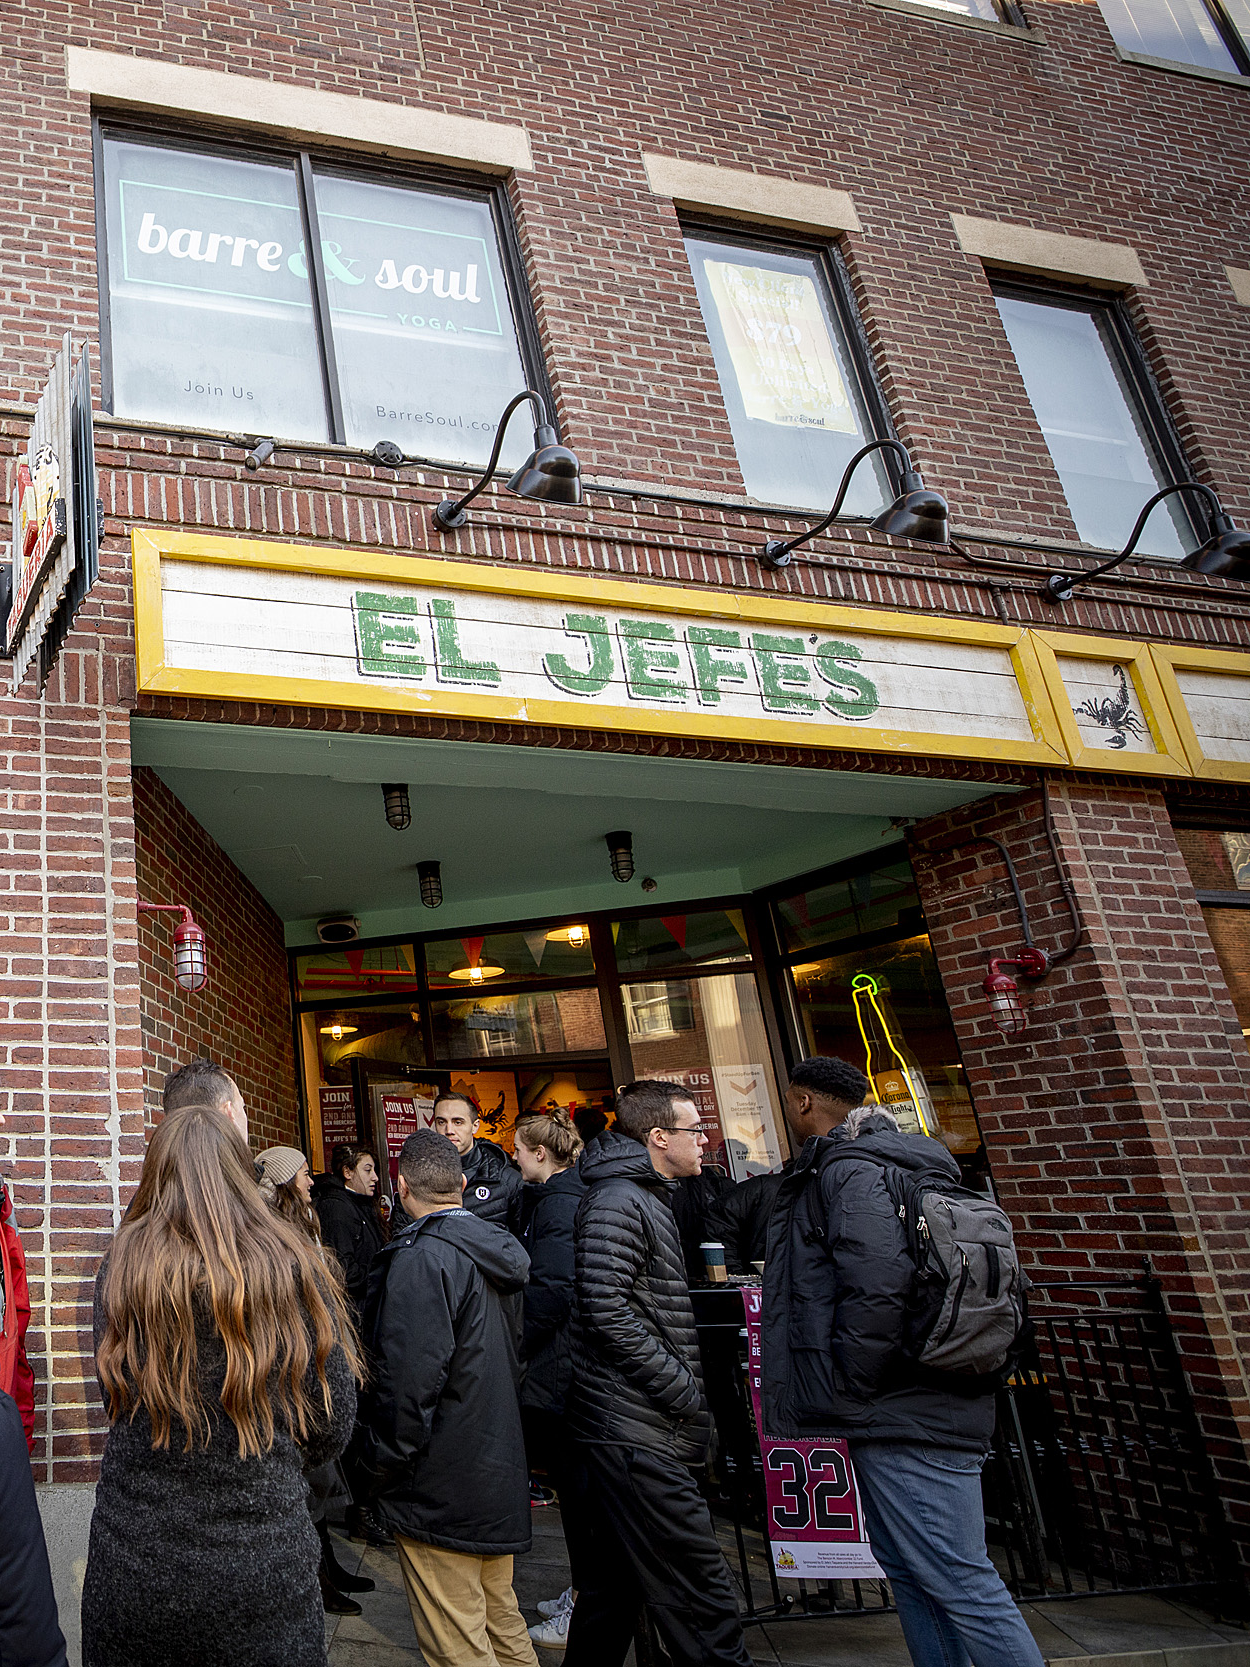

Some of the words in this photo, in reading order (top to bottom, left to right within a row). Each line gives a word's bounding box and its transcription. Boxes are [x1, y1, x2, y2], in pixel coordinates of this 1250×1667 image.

[137, 212, 283, 272] barre
[287, 238, 366, 286] &
[374, 259, 481, 304] soul
[396, 312, 458, 333] YOGA
[746, 317, 802, 346] $79
[184, 380, 224, 397] Join
[232, 386, 255, 400] Us
[351, 590, 502, 689] EL
[541, 611, 882, 722] JEFE'S
[689, 1073, 710, 1086] US
[322, 1092, 350, 1103] JOIN
[881, 1091, 911, 1104] Corona
[385, 1101, 403, 1114] JOIN
[404, 1103, 415, 1114] US
[890, 1103, 908, 1114] Light
[323, 1112, 339, 1120] 2ND
[341, 1112, 356, 1120] ANN
[767, 1447, 854, 1530] 32
